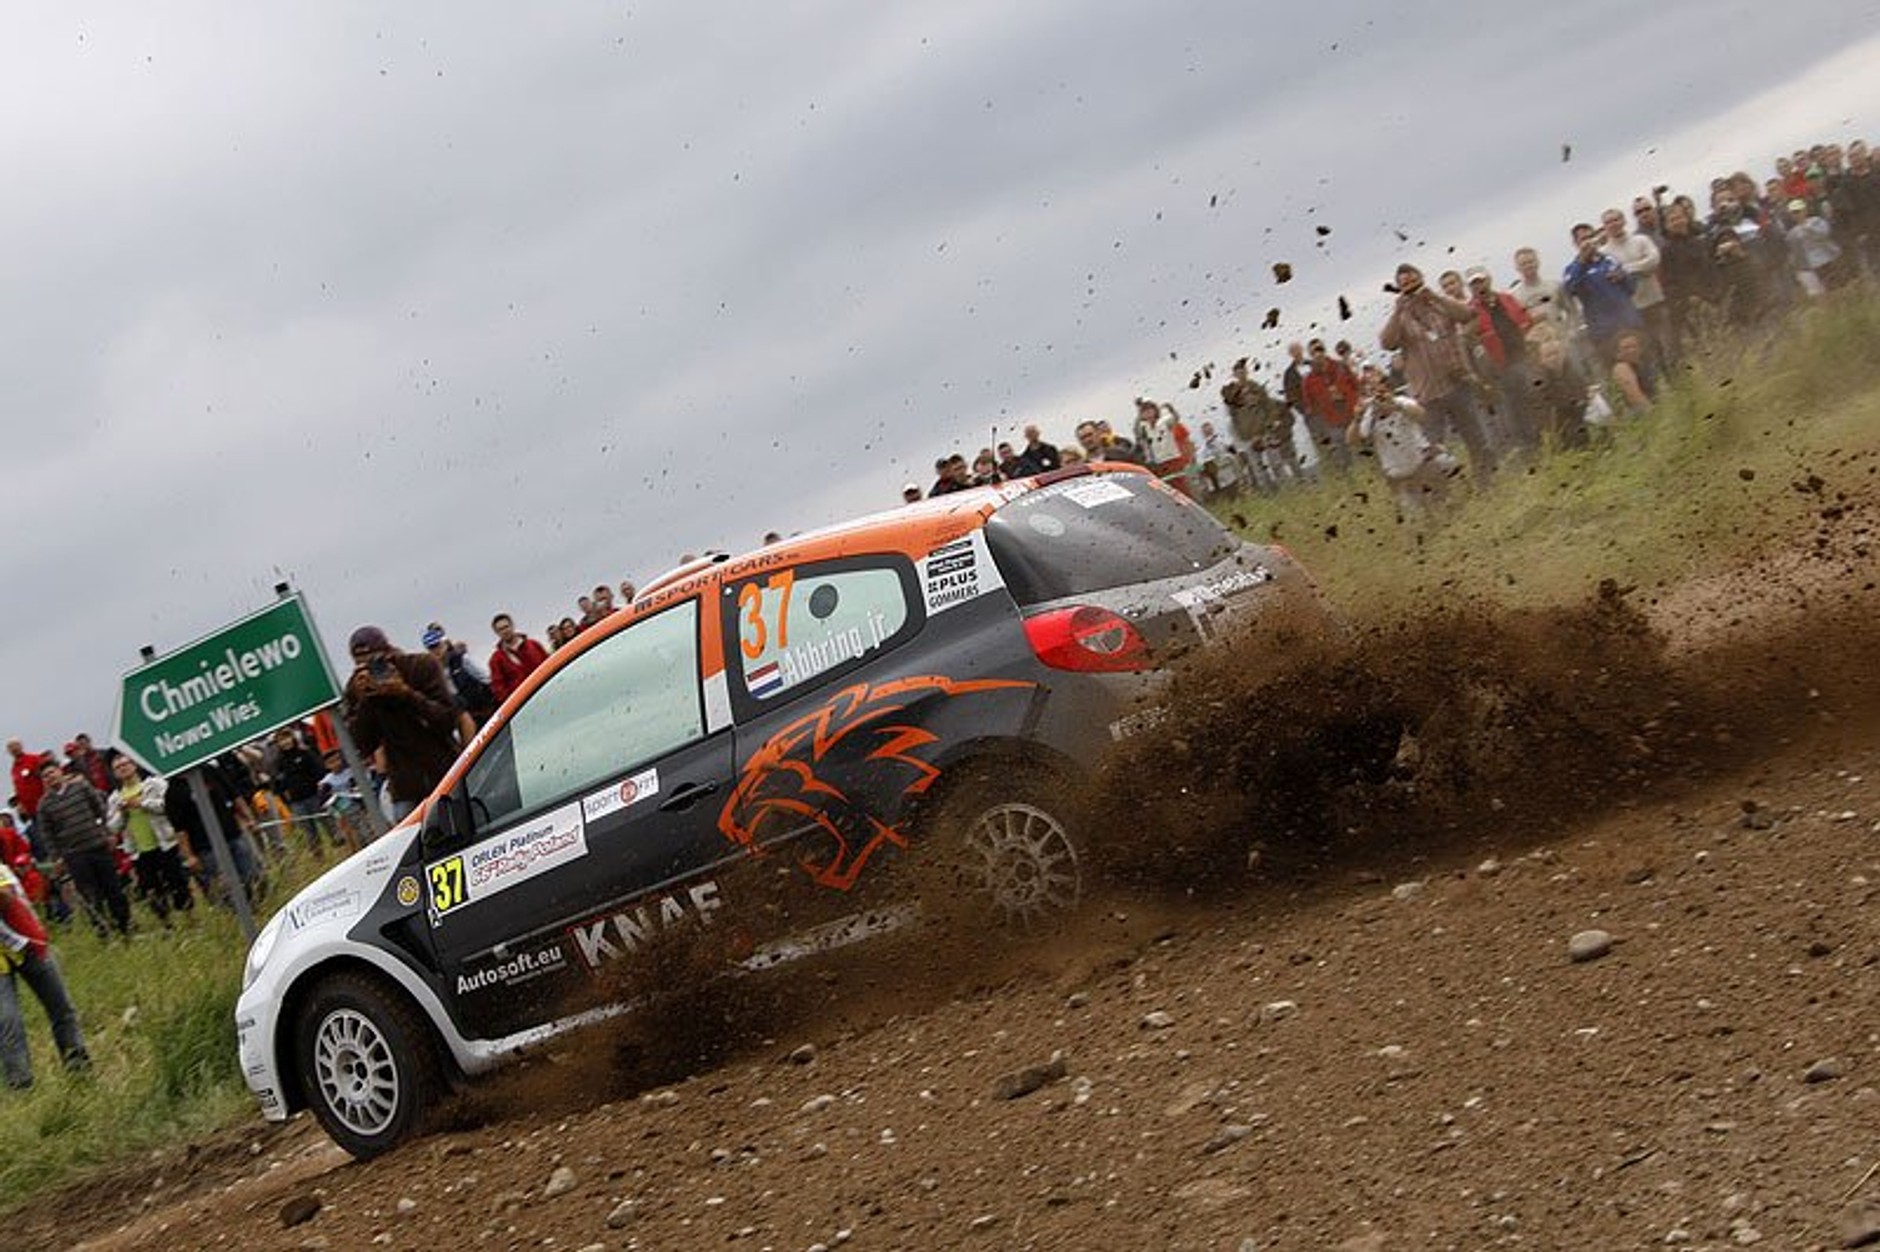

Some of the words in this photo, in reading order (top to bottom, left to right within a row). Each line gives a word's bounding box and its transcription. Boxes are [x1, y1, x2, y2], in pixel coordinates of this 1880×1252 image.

[929, 583, 979, 608] GOMMERS
[940, 569, 977, 591] PLUS
[738, 568, 794, 660] 37
[141, 634, 300, 722] Chmielewo
[784, 627, 864, 682] Abbring
[155, 723, 213, 758] Nowa
[209, 692, 262, 732] Wieś
[472, 843, 507, 867] ORLEN
[510, 824, 554, 852] Platinum
[432, 856, 464, 911] 37
[457, 945, 562, 995] Autosoft.eu
